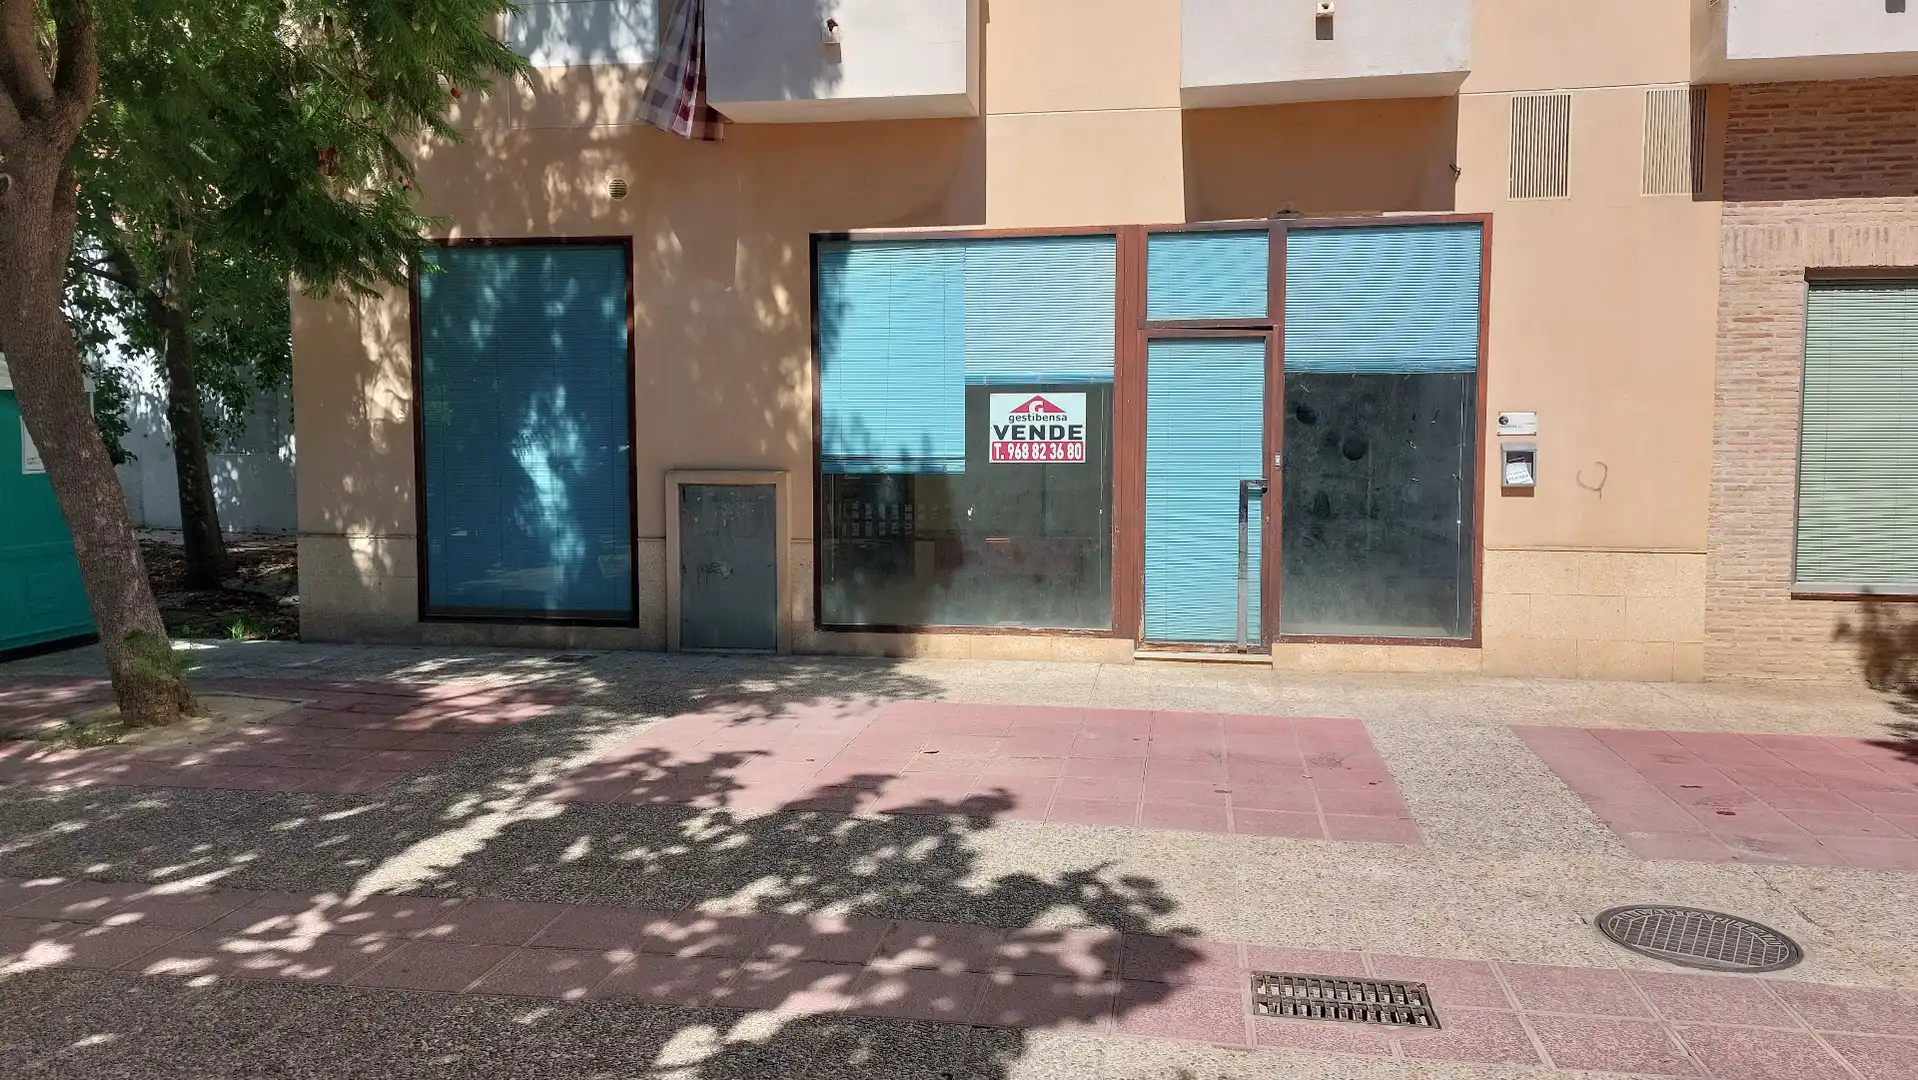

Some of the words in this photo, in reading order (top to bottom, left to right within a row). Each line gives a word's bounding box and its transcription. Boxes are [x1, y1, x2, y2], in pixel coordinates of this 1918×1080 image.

[1008, 413, 1068, 424] gestibensa
[993, 424, 1083, 440] VENDE
[993, 443, 1005, 460] T.
[1007, 443, 1029, 460] 968
[1032, 443, 1046, 460] 82
[1049, 443, 1064, 460] 36
[1067, 443, 1082, 460] 80
